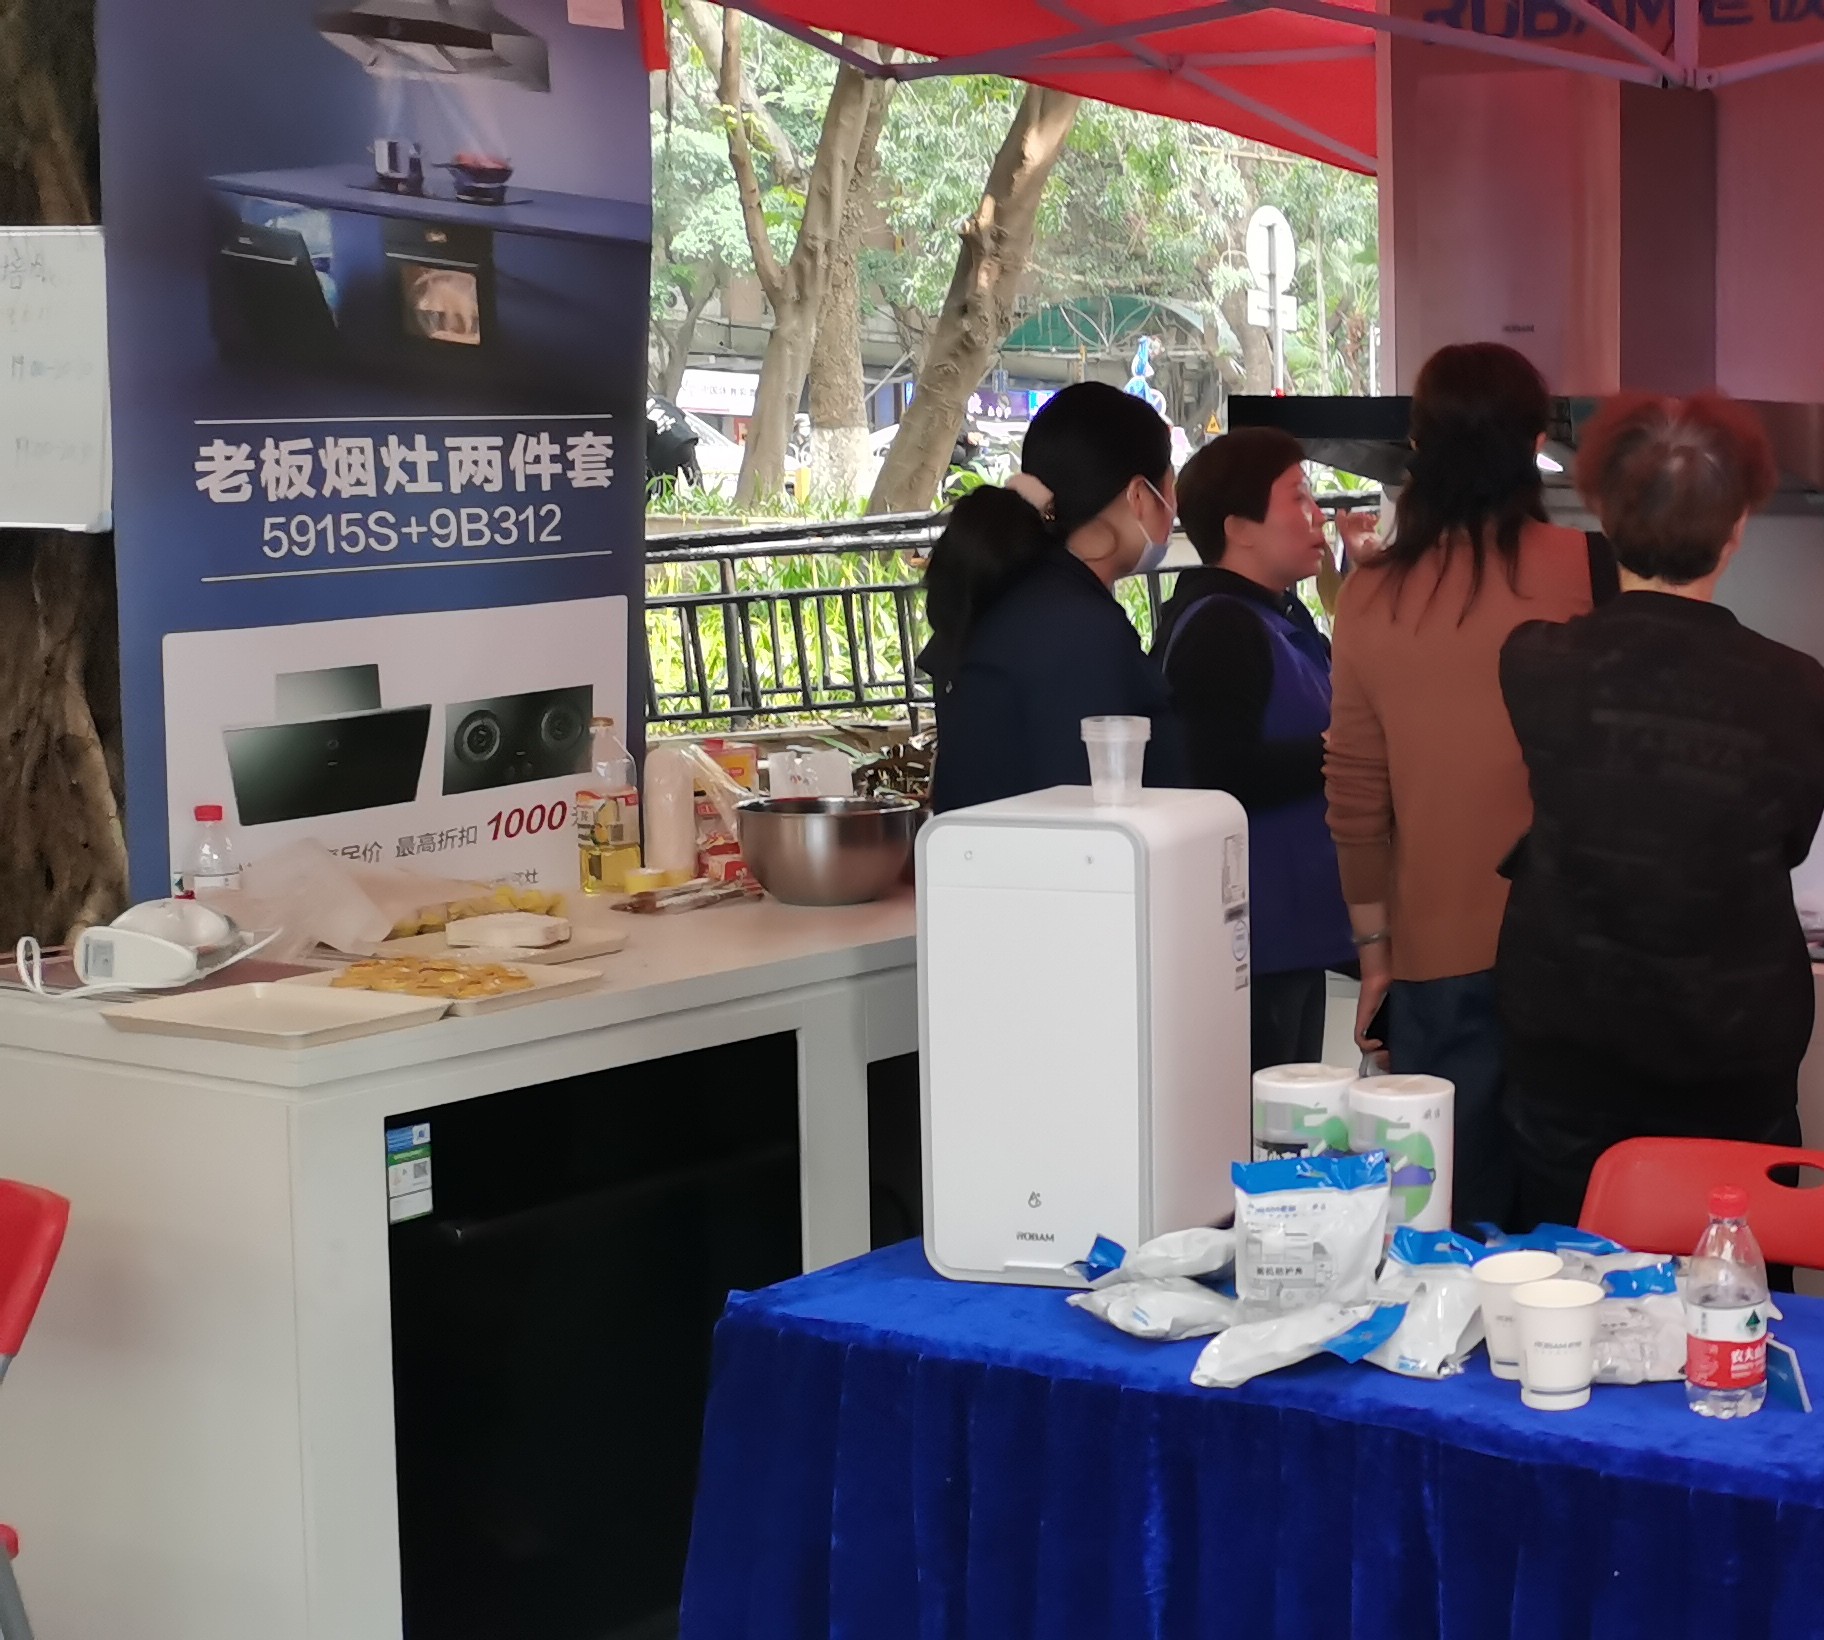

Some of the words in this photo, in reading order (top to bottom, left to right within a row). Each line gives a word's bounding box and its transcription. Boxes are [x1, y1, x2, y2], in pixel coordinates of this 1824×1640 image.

[194, 431, 614, 502] 老板烟灶两件套
[261, 503, 563, 559] 5915S+9B312
[395, 825, 479, 859] 最高折扣
[487, 800, 568, 841] 1000
[1016, 1231, 1054, 1242] ROBAM
